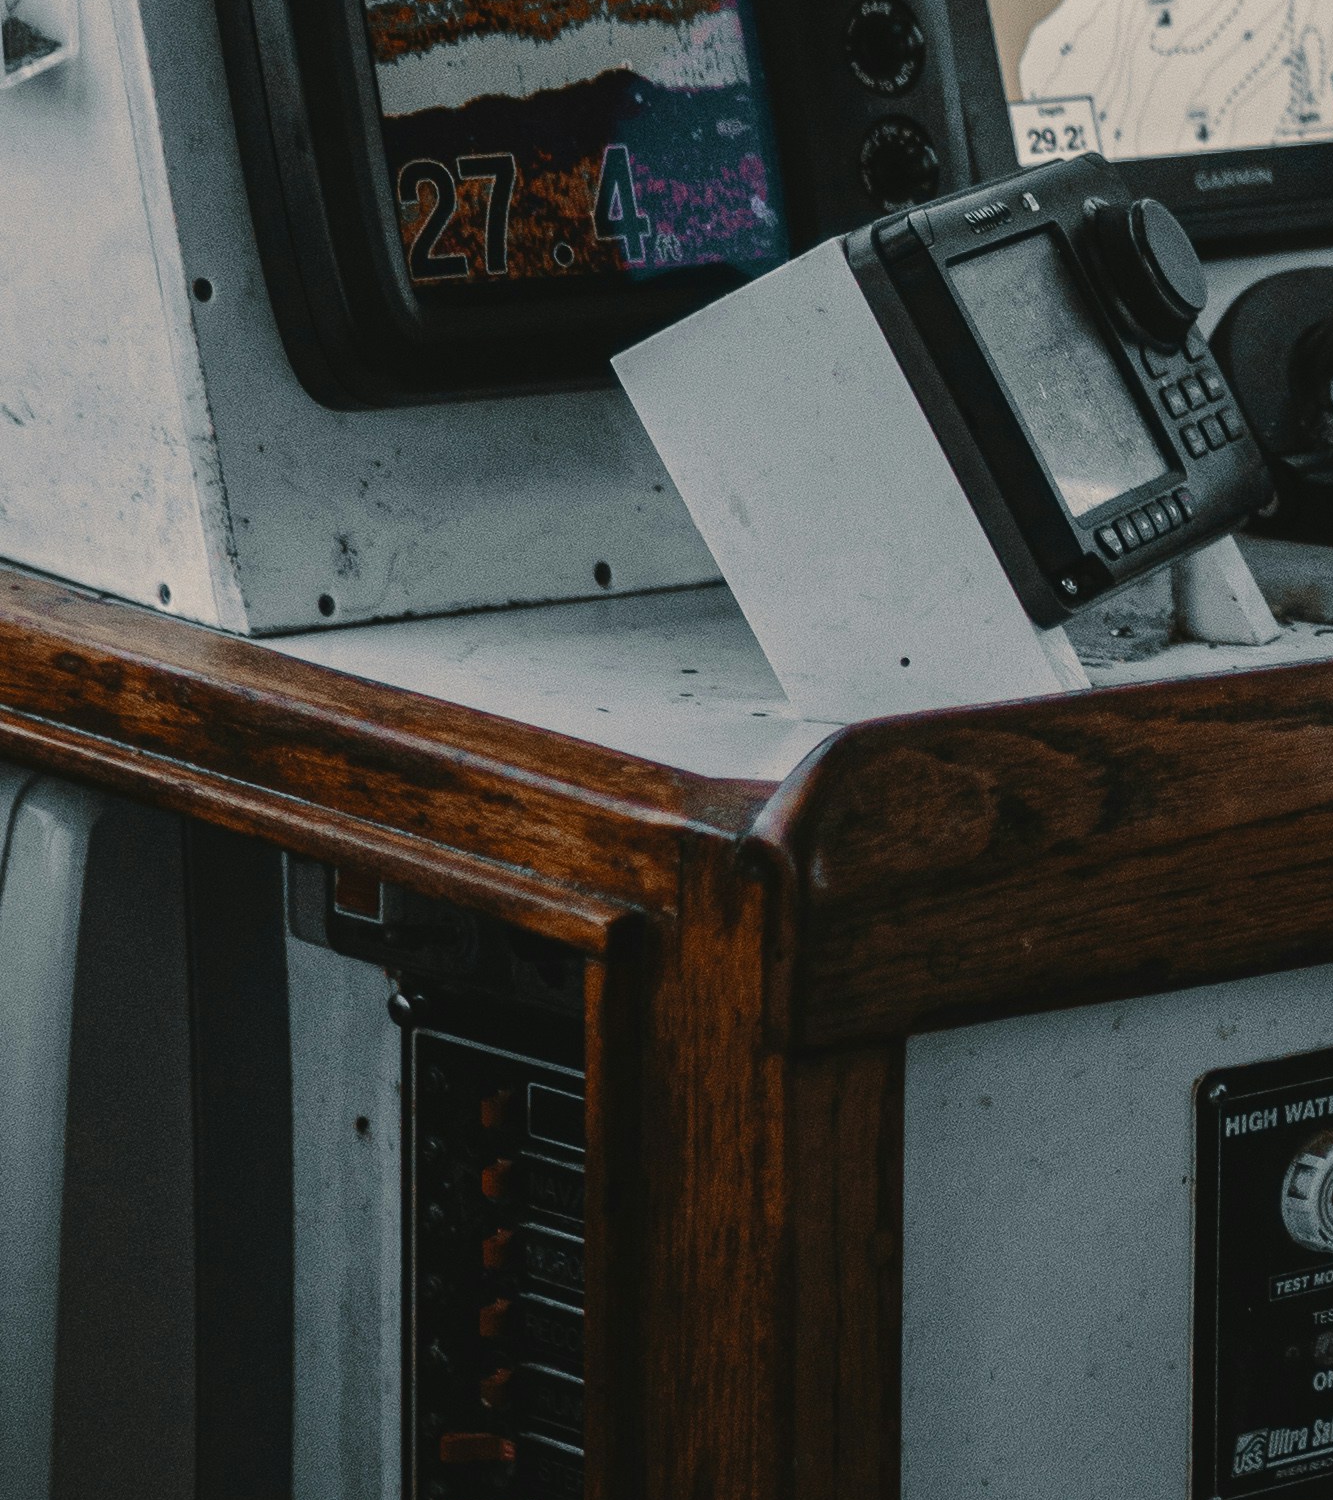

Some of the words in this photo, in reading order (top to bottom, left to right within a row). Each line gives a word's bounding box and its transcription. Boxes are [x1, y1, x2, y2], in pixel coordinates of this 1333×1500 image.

[1194, 168, 1273, 192] GARMIN
[1224, 1106, 1278, 1138] HIGH
[1275, 1275, 1310, 1295] TEST
[1267, 1426, 1309, 1458] Ultra
[1234, 1450, 1264, 1477] USS
